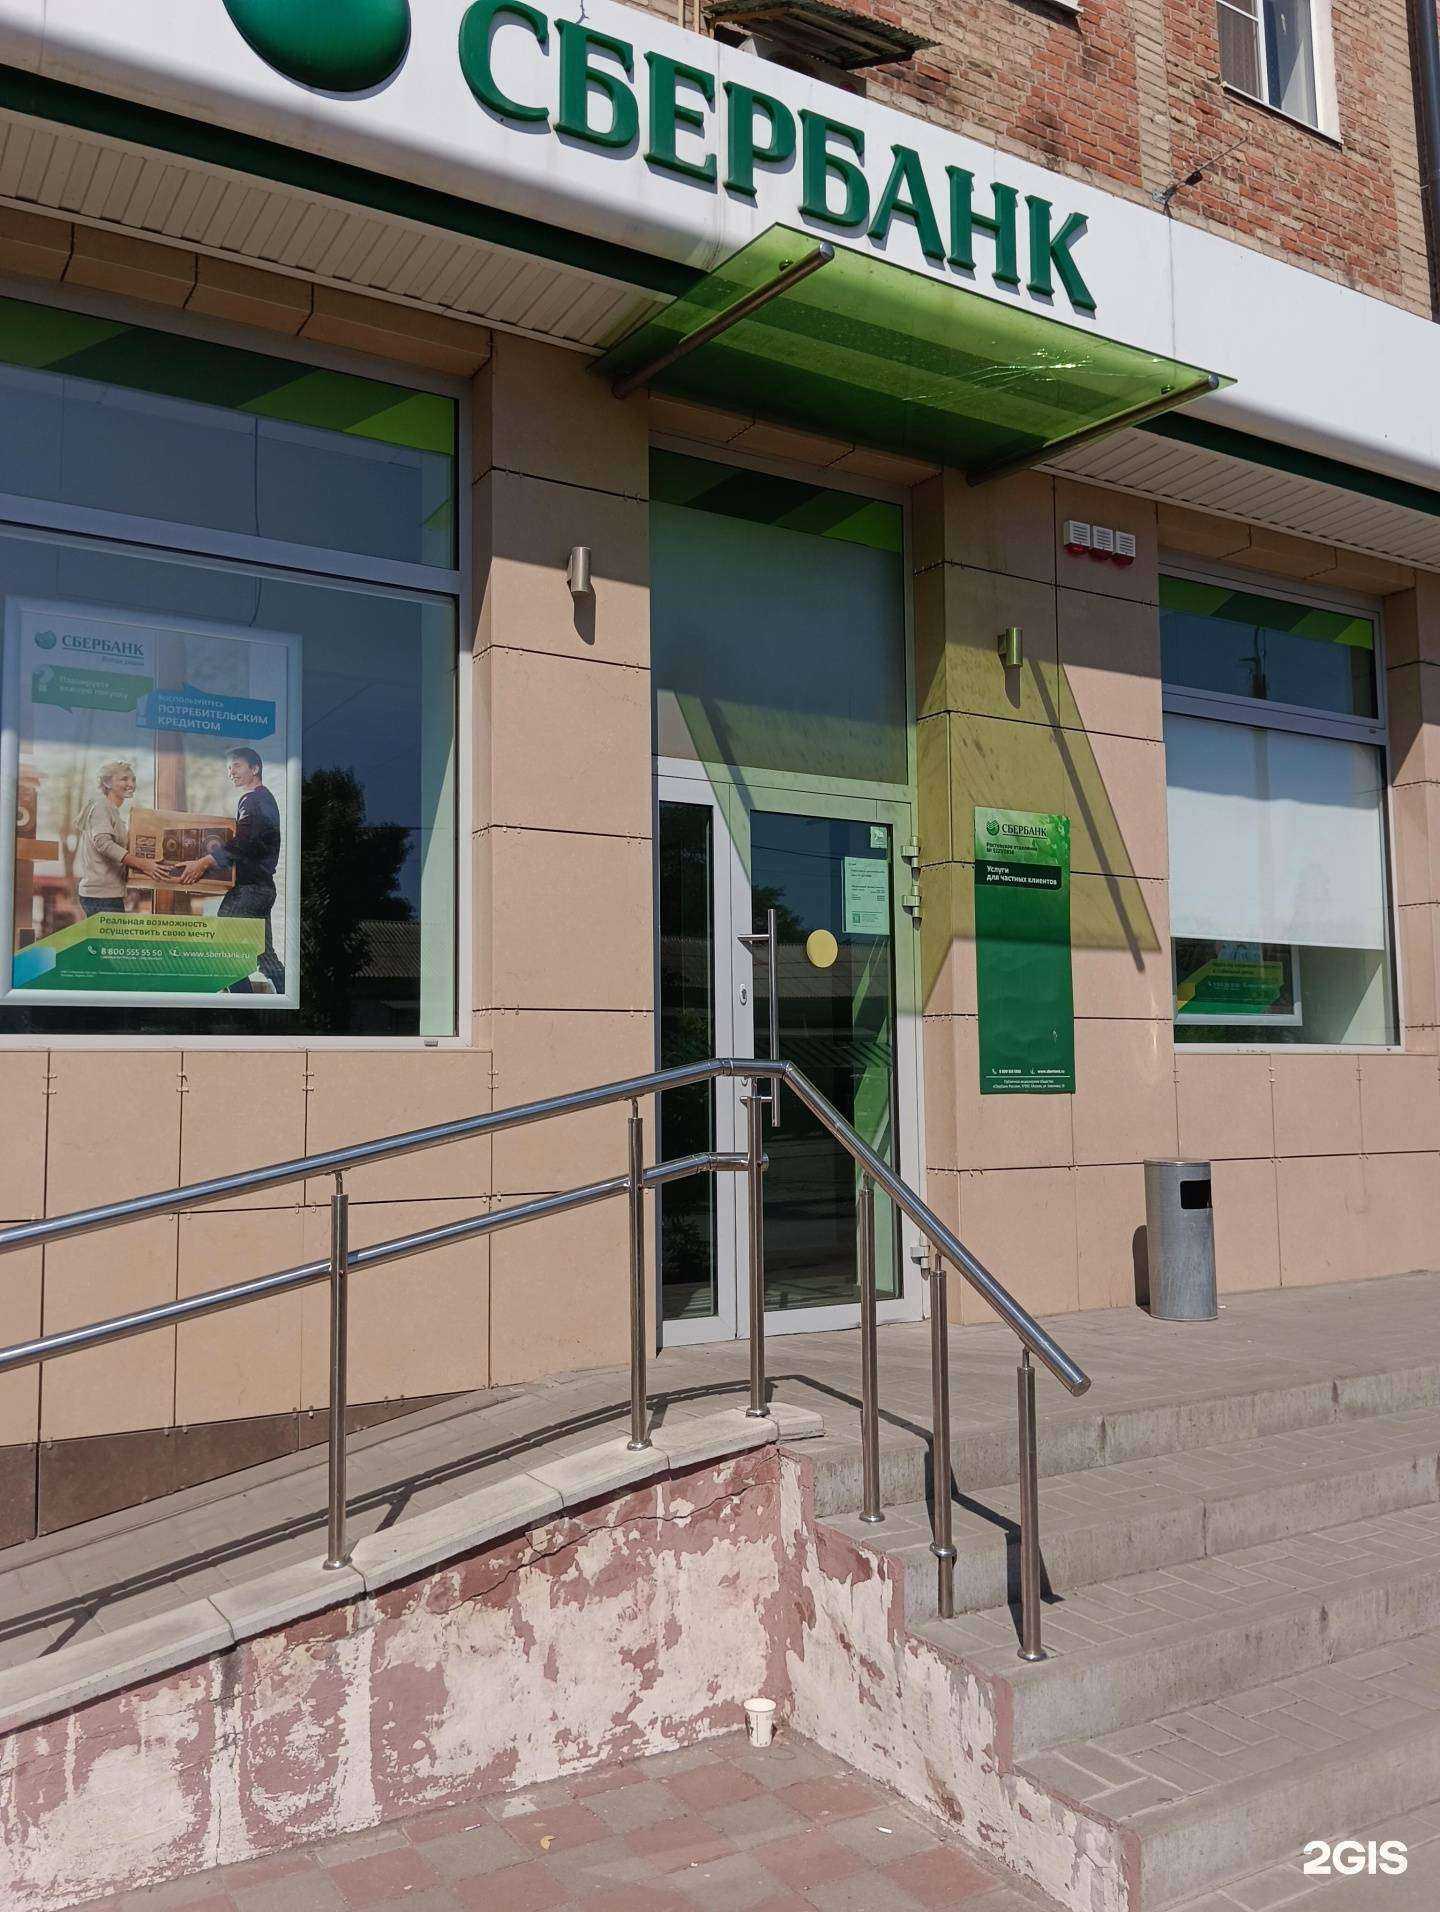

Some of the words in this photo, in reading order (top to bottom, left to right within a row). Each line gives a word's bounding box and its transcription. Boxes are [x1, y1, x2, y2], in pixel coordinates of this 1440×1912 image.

[458, 0, 1096, 310] СБЕРБАНК
[62, 635, 144, 656] СБЕРБАНК
[158, 704, 268, 725] ПОТРЕБИТЕЛЬСКИМ
[158, 716, 221, 731] КРЕДИТОМ
[1001, 823, 1047, 837] СБЕРБАНК
[986, 865, 1009, 875] Услуги
[986, 874, 1000, 882] для
[1000, 875, 1027, 883] частных
[1027, 877, 1058, 885] клиентов
[99, 916, 145, 926] Реальная
[146, 919, 208, 928] возможность
[99, 927, 161, 937] осуществить
[188, 931, 216, 939] мечту
[126, 948, 140, 956] 555
[141, 949, 151, 957] 55
[152, 949, 163, 957] 50
